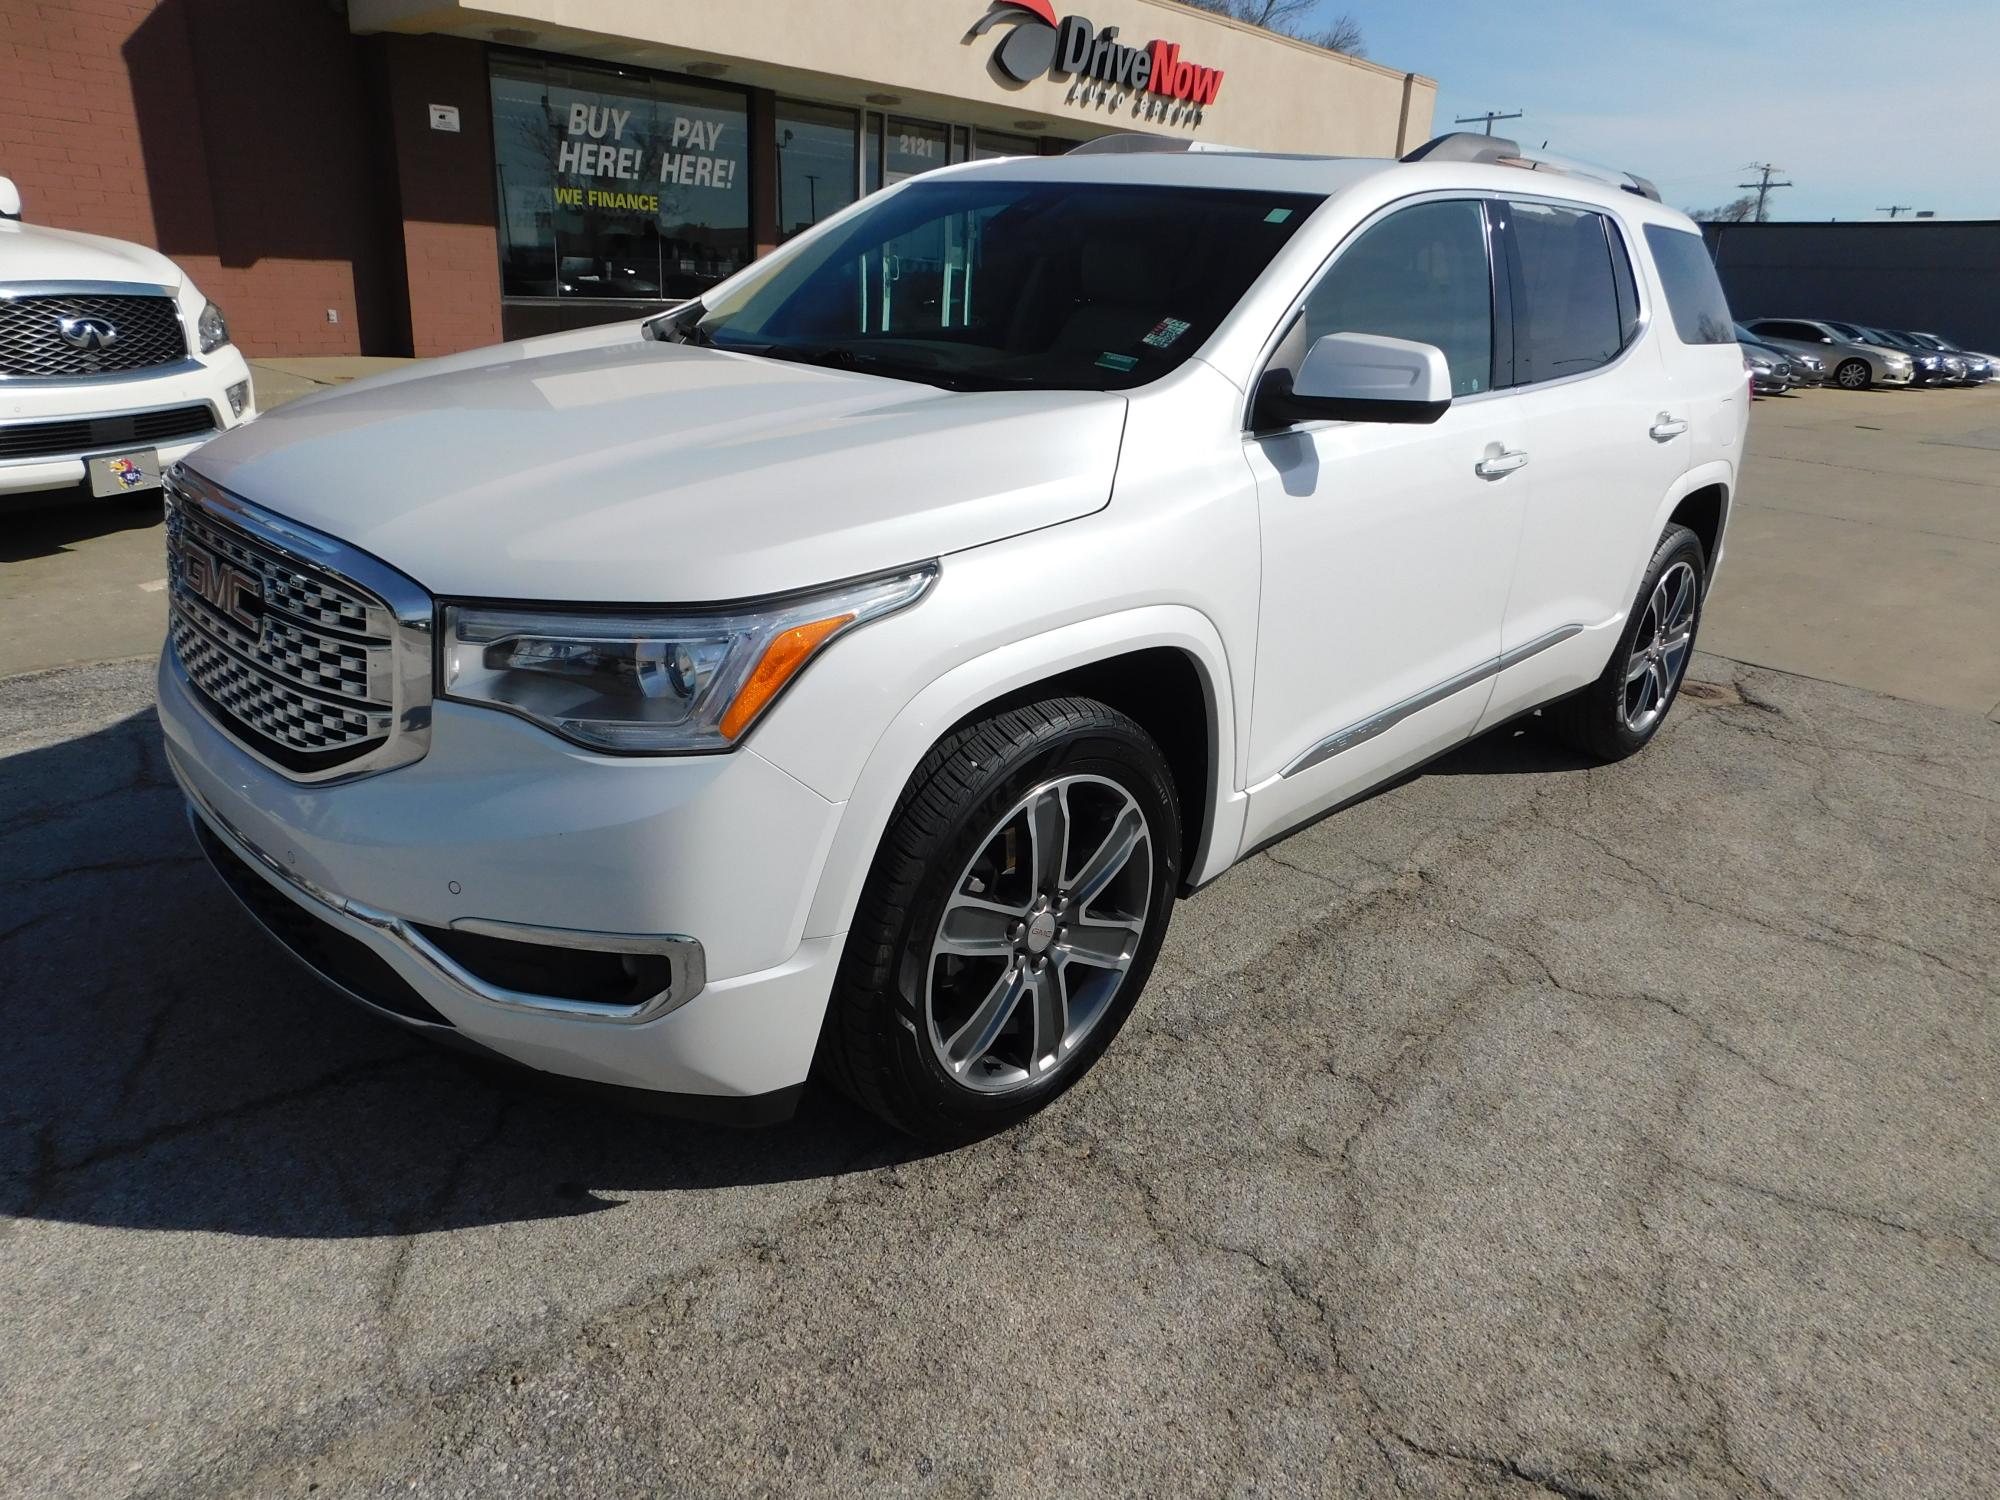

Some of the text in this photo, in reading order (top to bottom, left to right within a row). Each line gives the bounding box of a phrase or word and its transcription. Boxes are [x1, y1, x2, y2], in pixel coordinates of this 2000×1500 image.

[1055, 15, 1225, 105] DriveNow
[1072, 83, 1126, 110] AUTO
[568, 103, 630, 140] BUY
[671, 117, 724, 150] PAY
[558, 141, 643, 180] HERE!
[900, 134, 933, 158] 2121
[660, 152, 736, 189] HERE!
[554, 187, 659, 212] WE FINANCE
[181, 541, 261, 634] GMC
[1031, 927, 1052, 938] GMC
